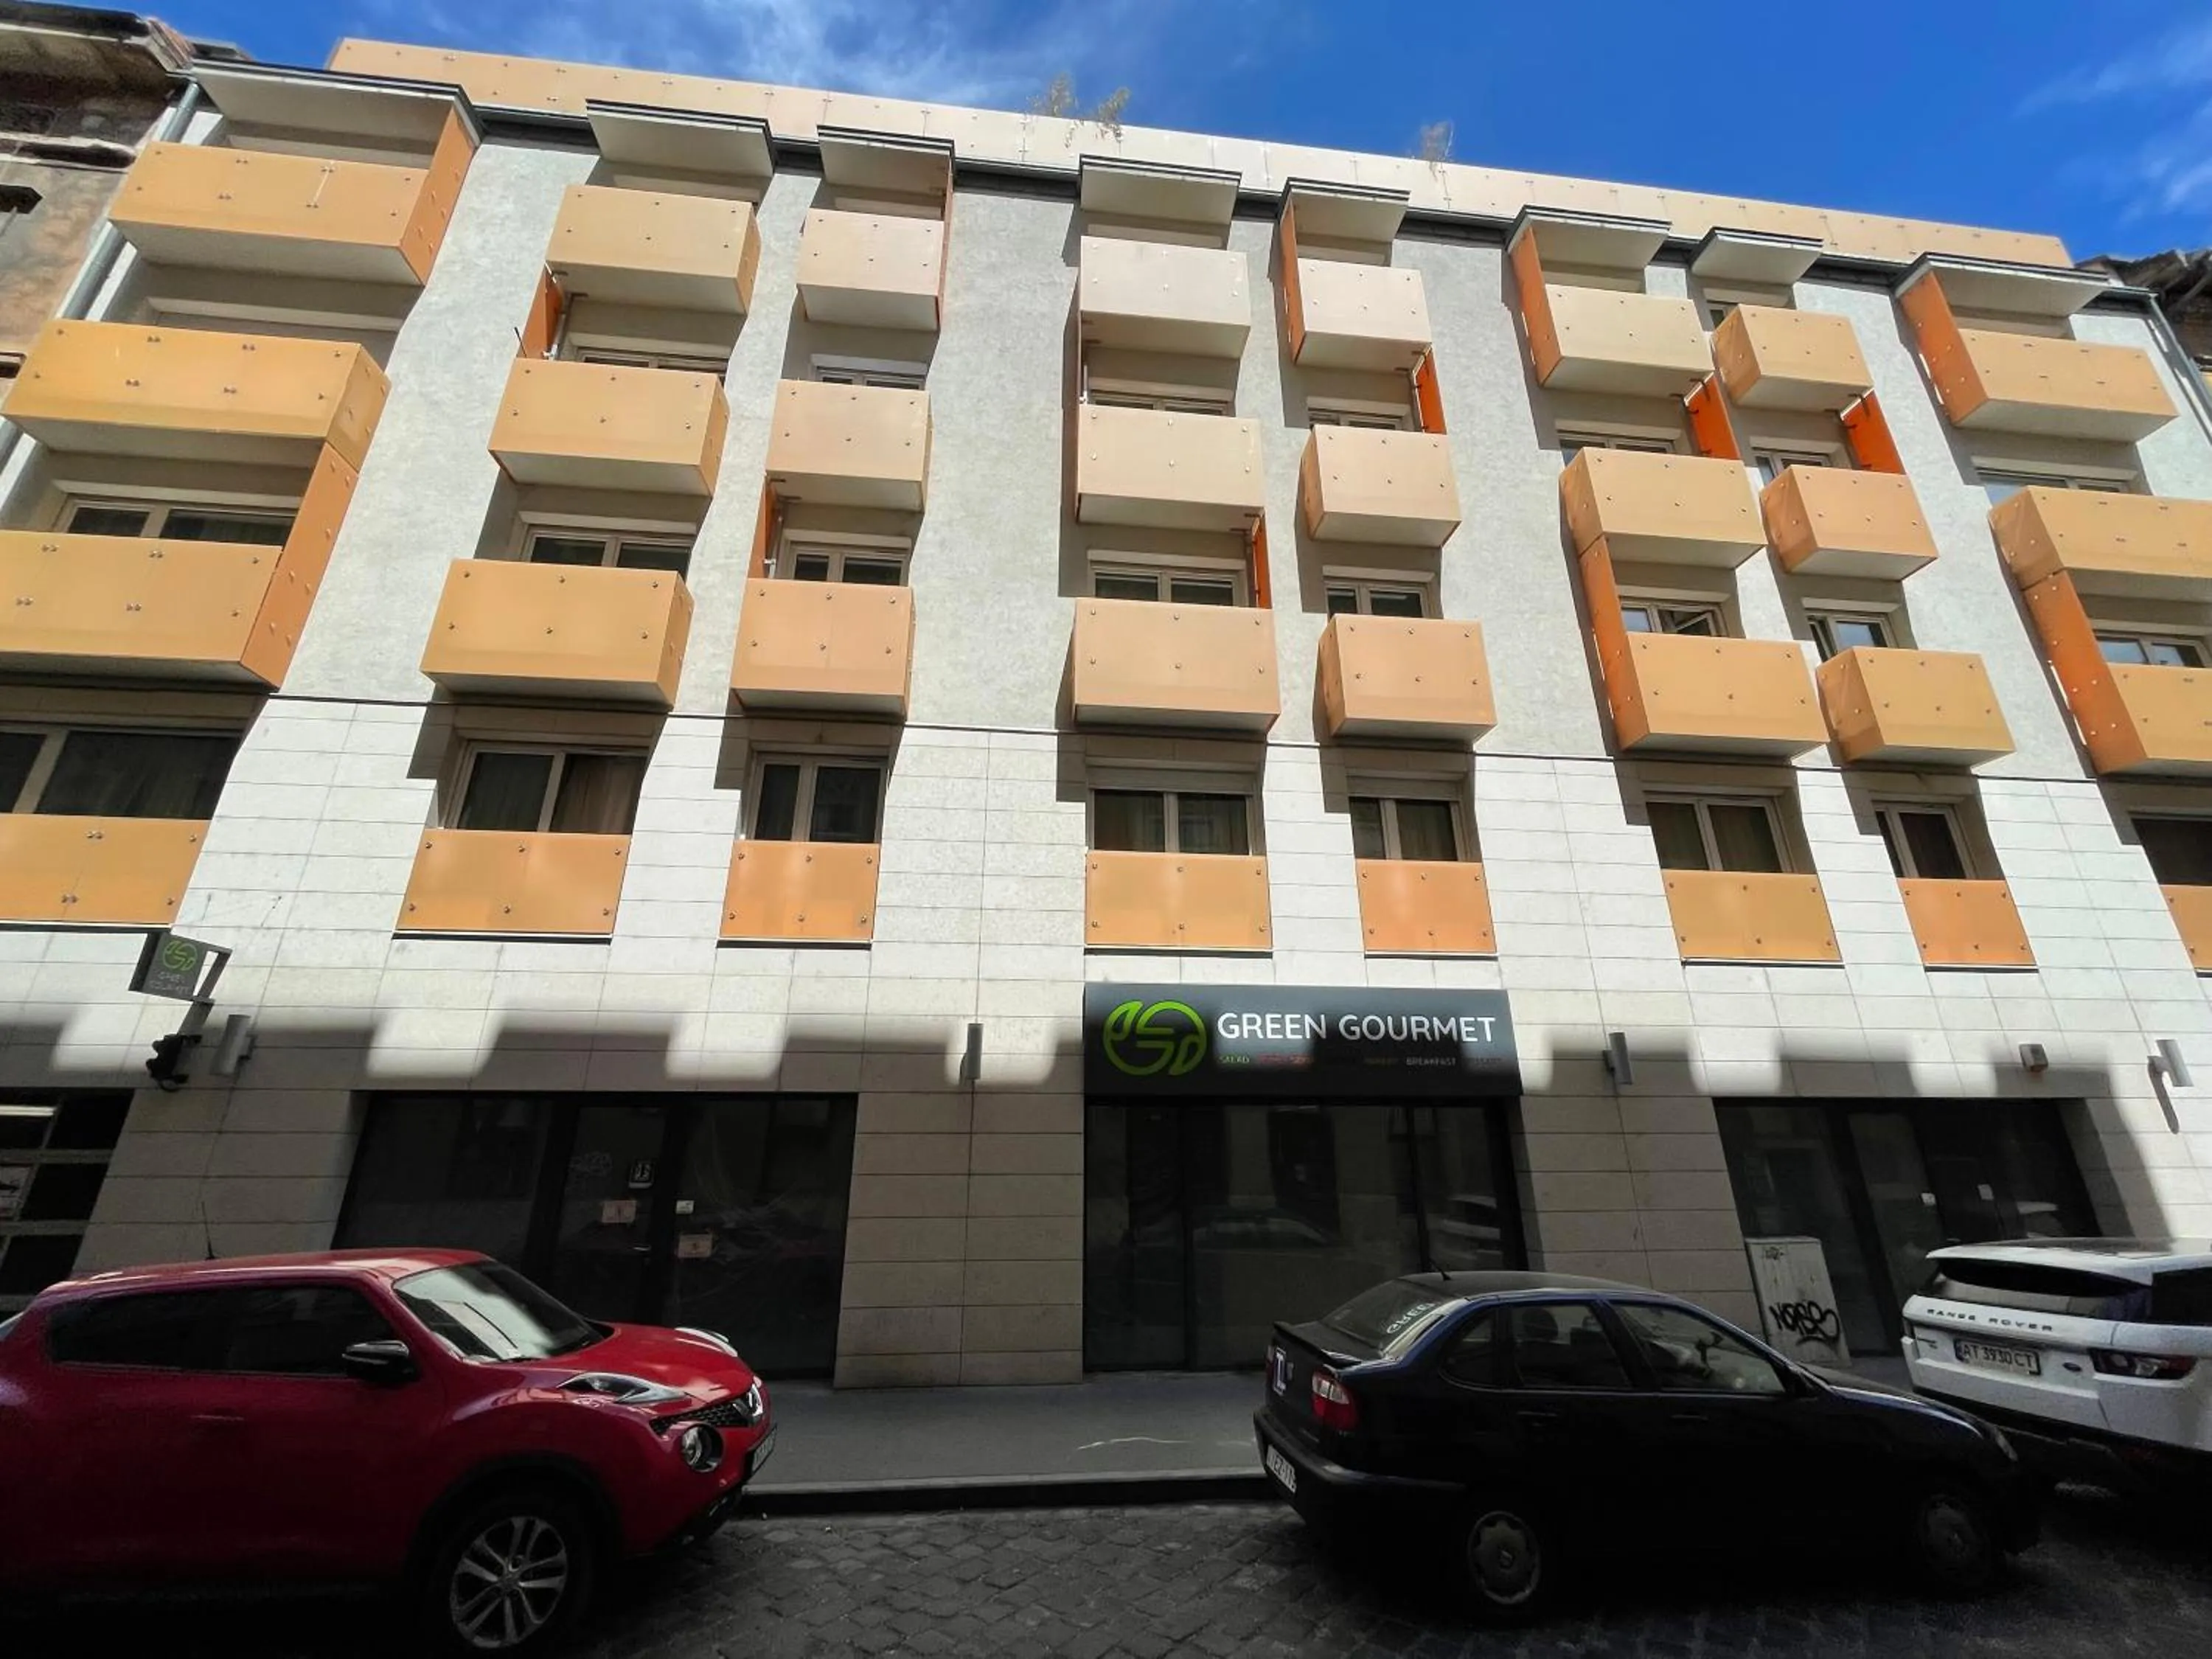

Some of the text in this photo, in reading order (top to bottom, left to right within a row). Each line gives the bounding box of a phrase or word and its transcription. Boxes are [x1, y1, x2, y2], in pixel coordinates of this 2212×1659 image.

[1217, 1012, 1496, 1042] GREEN GOURMET
[1405, 1057, 1456, 1066] BREAKFAST
[1927, 1309, 2053, 1332] RANGE ROVER
